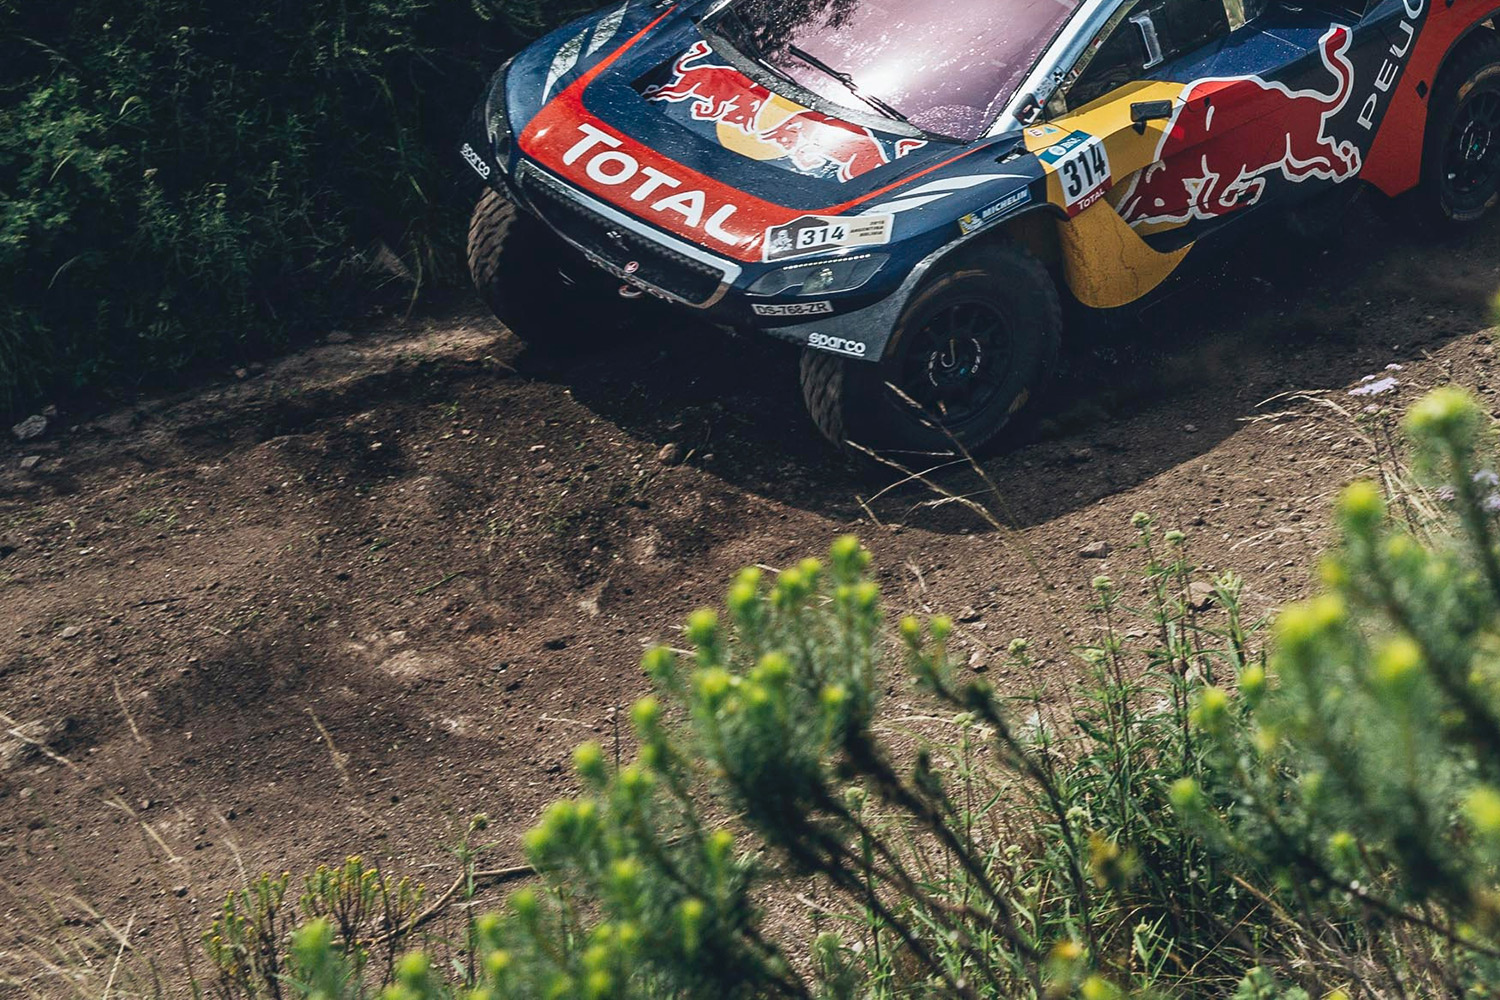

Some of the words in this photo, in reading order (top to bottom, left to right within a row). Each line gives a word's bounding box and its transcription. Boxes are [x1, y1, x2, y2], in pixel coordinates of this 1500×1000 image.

[460, 142, 490, 178] sparco
[1063, 143, 1106, 198] 314
[562, 122, 743, 246] TOTAL
[1077, 188, 1106, 210] TOTAL
[981, 188, 1028, 218] MICHELIN
[802, 226, 845, 245] 314
[808, 332, 866, 354] sparco
